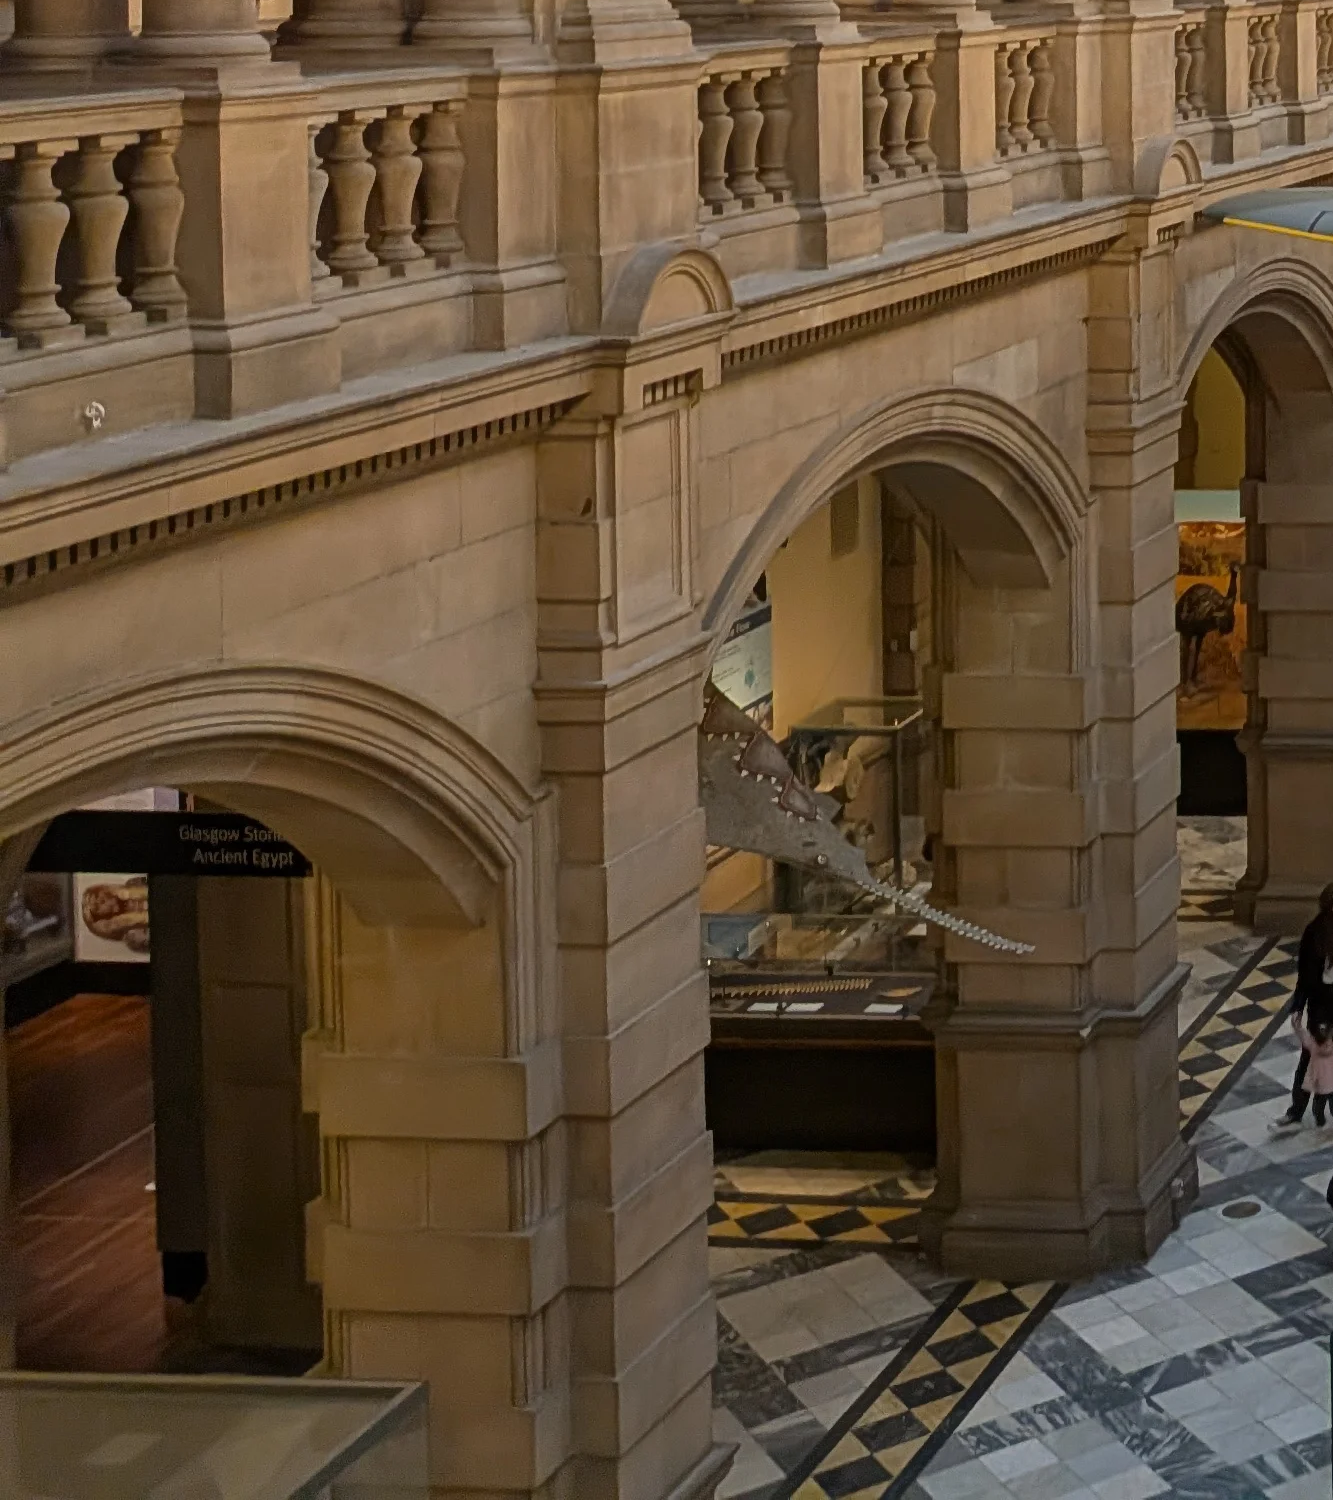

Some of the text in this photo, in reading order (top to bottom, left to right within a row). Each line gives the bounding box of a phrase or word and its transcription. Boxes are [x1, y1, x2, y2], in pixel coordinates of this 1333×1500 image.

[179, 824, 240, 845] Glasgow
[193, 848, 293, 869] Ancient Egypt
